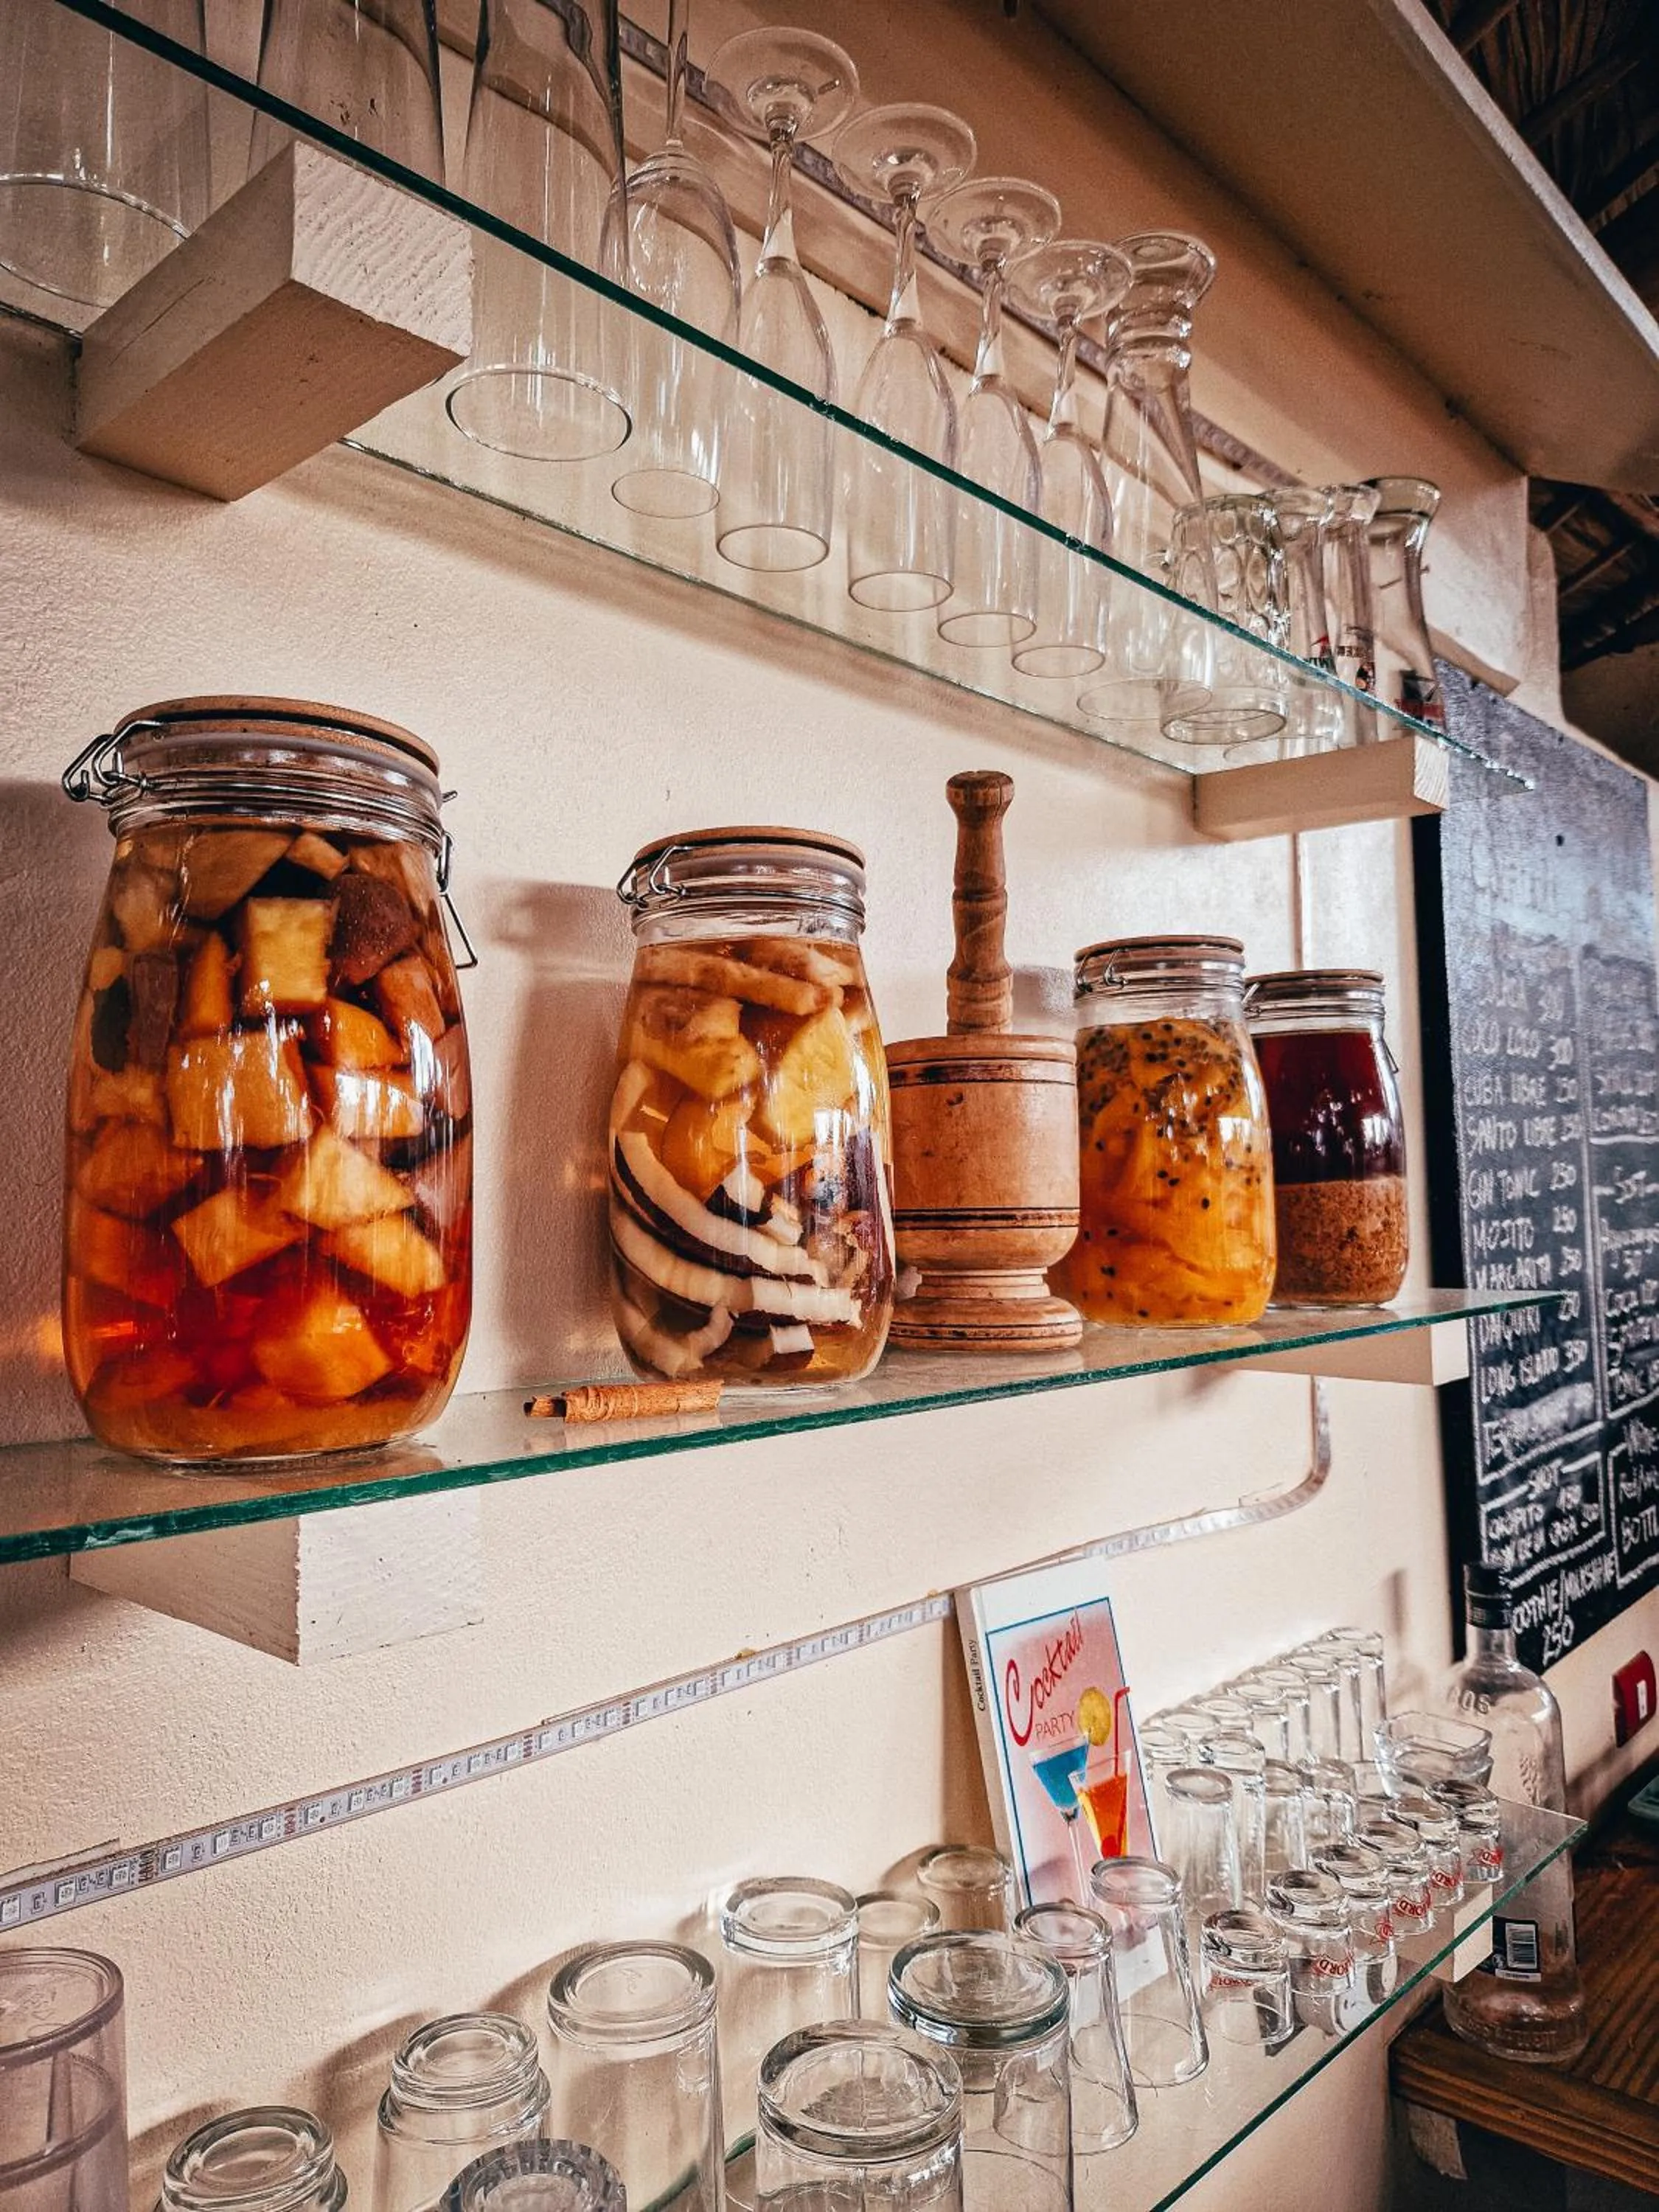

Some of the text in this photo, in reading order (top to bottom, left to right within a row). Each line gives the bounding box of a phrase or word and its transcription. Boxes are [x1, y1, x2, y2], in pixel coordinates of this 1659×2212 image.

[1464, 1073, 1503, 1106] CUBA
[1467, 1115, 1518, 1156] SANTO
[1467, 1168, 1494, 1210] GIN
[1472, 1217, 1535, 1258] MOJITO
[1480, 1364, 1517, 1403] LONG
[1542, 1613, 1575, 1667] 250
[970, 1666, 986, 1712] Cocktail
[1004, 1608, 1083, 1747] Cocktail
[1034, 1710, 1076, 1741] PARTY
